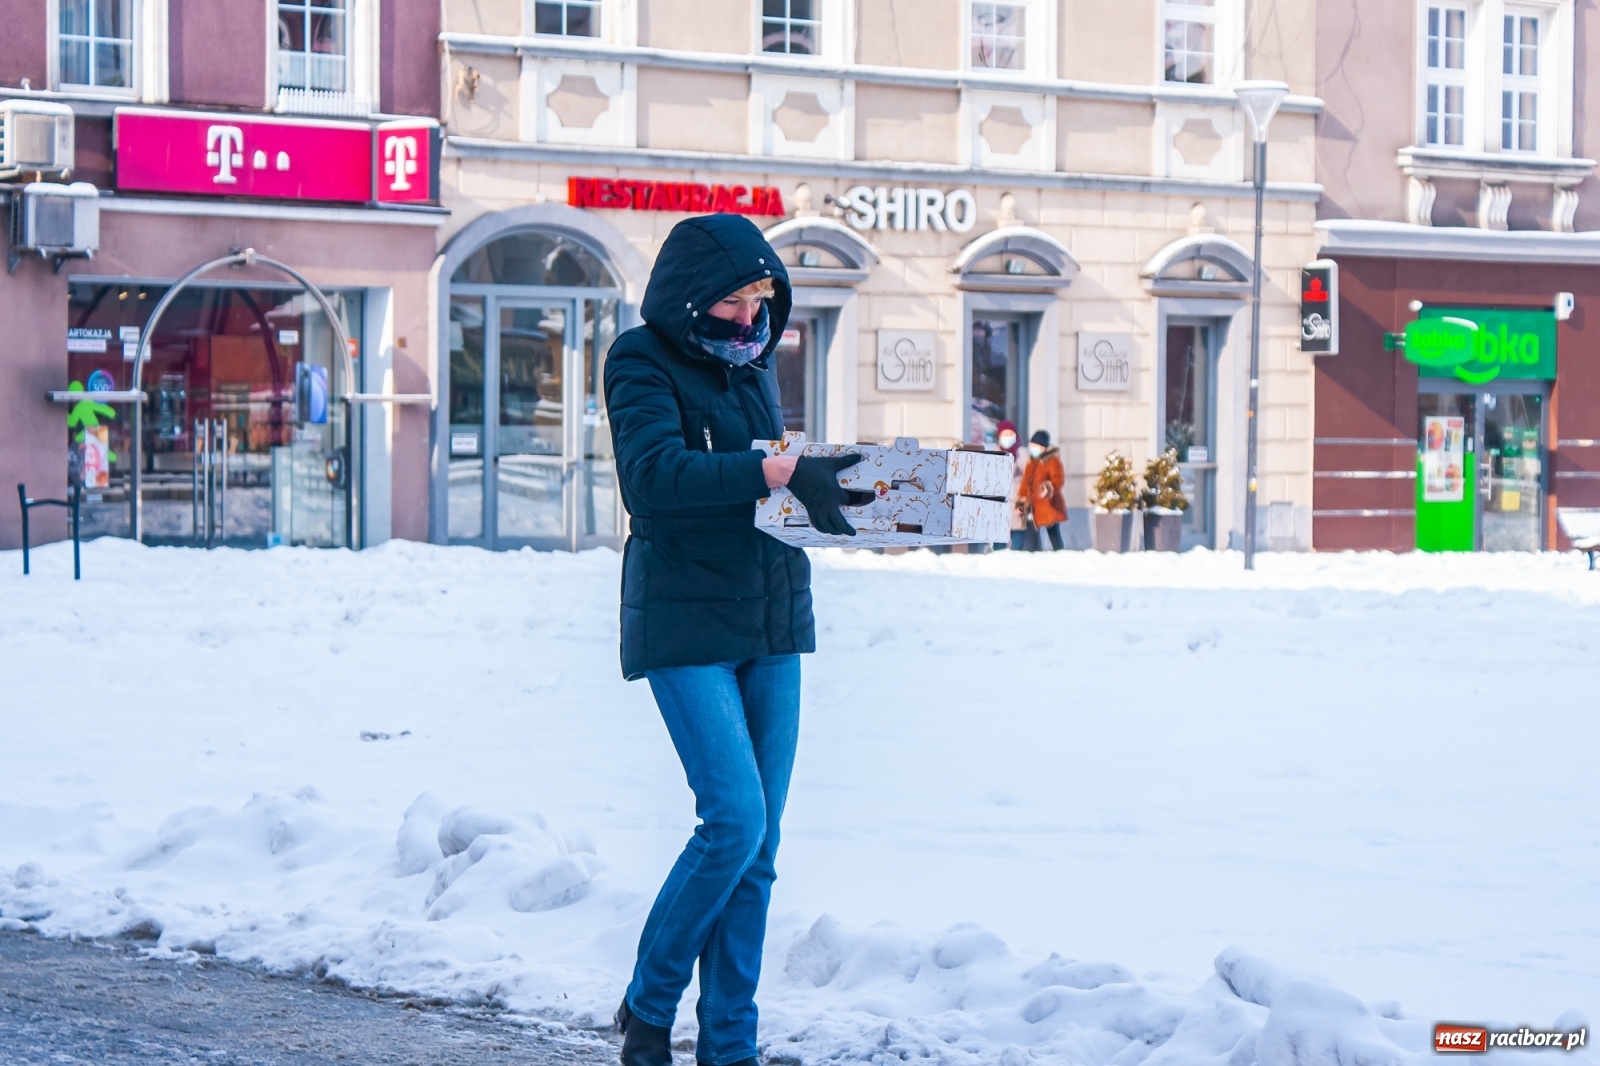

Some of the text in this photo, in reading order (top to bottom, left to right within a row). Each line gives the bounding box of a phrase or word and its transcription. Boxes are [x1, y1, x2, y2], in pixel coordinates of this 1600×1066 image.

[206, 124, 245, 184] T
[384, 134, 418, 192] T
[568, 176, 977, 232] RESTAURACJA SHIRO
